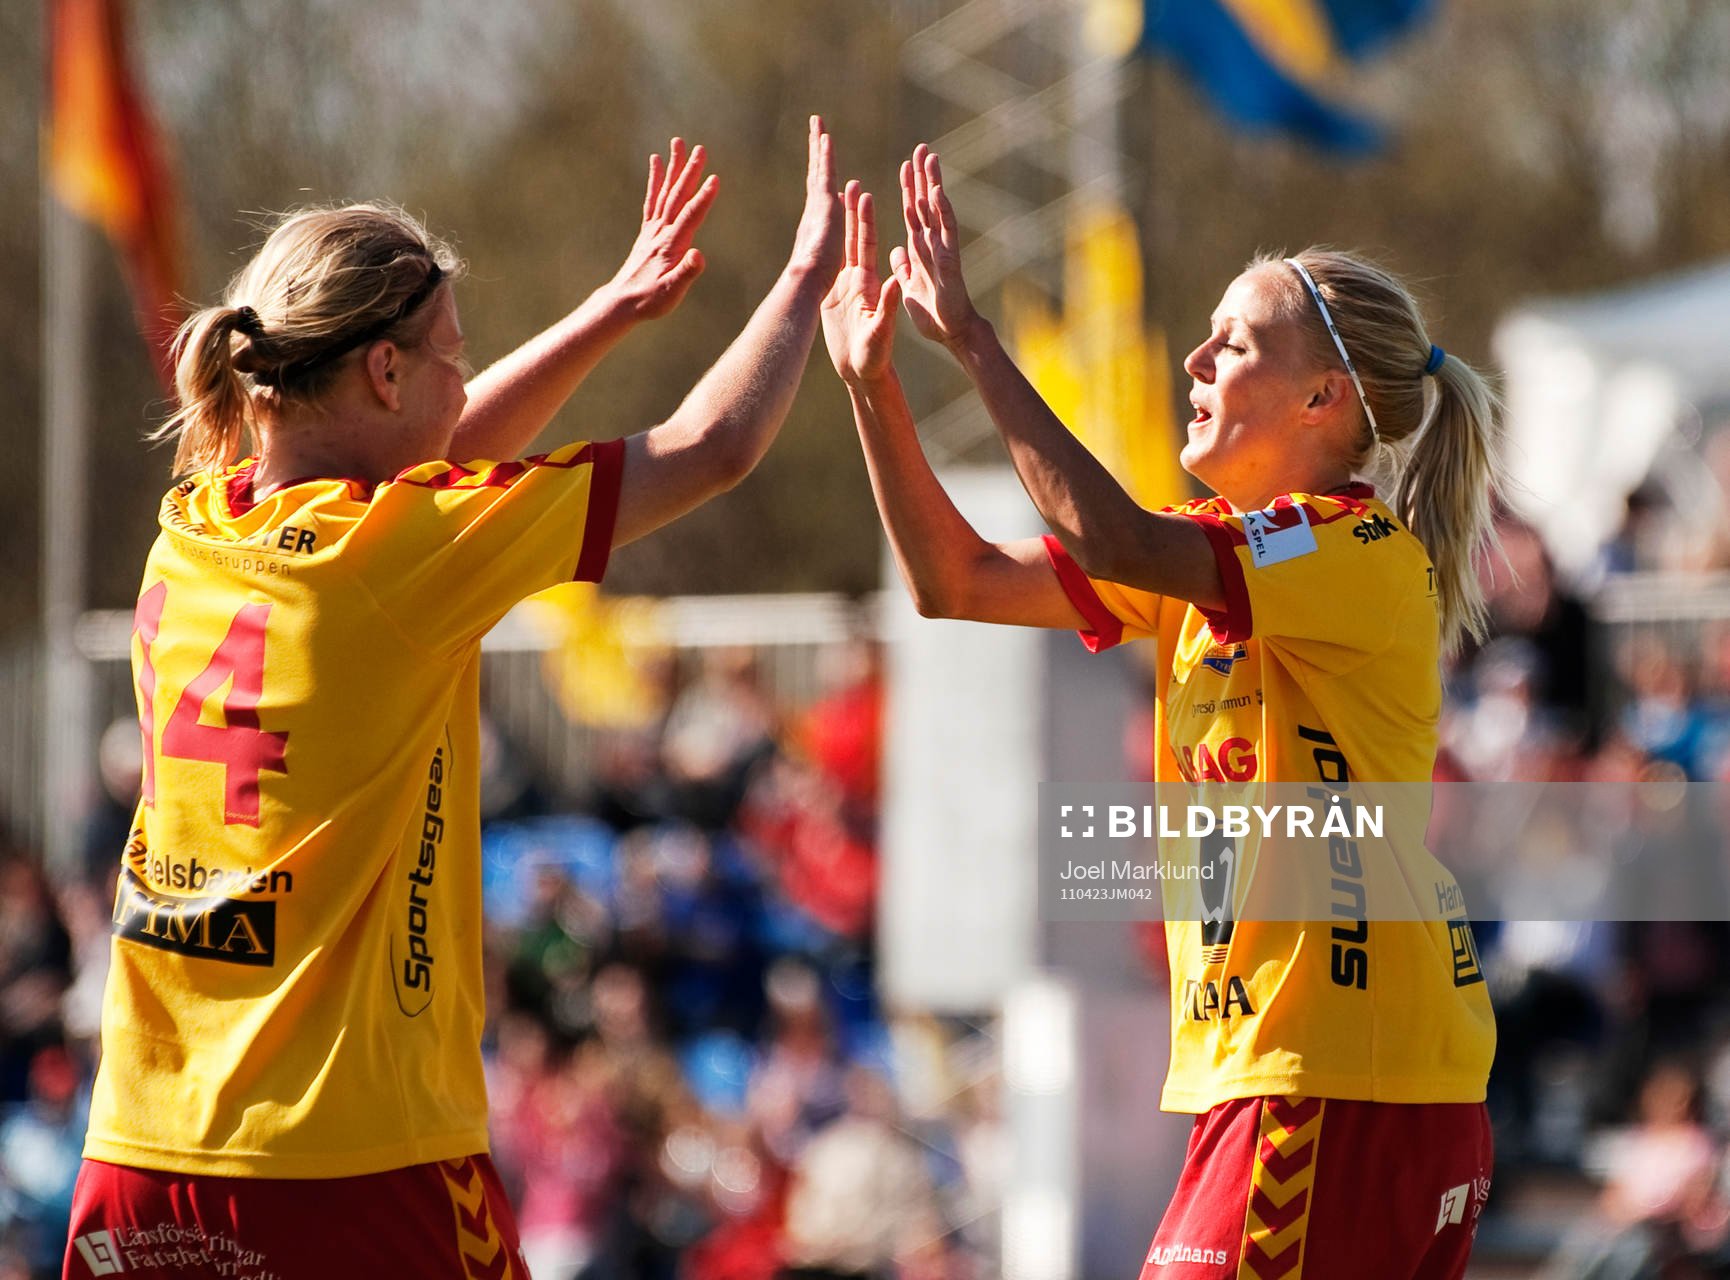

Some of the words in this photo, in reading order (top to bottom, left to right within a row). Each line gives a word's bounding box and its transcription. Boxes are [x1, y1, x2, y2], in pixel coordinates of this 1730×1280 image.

[1251, 528, 1266, 559] SPEL
[212, 550, 291, 576] Gruppen
[131, 579, 290, 828] 14
